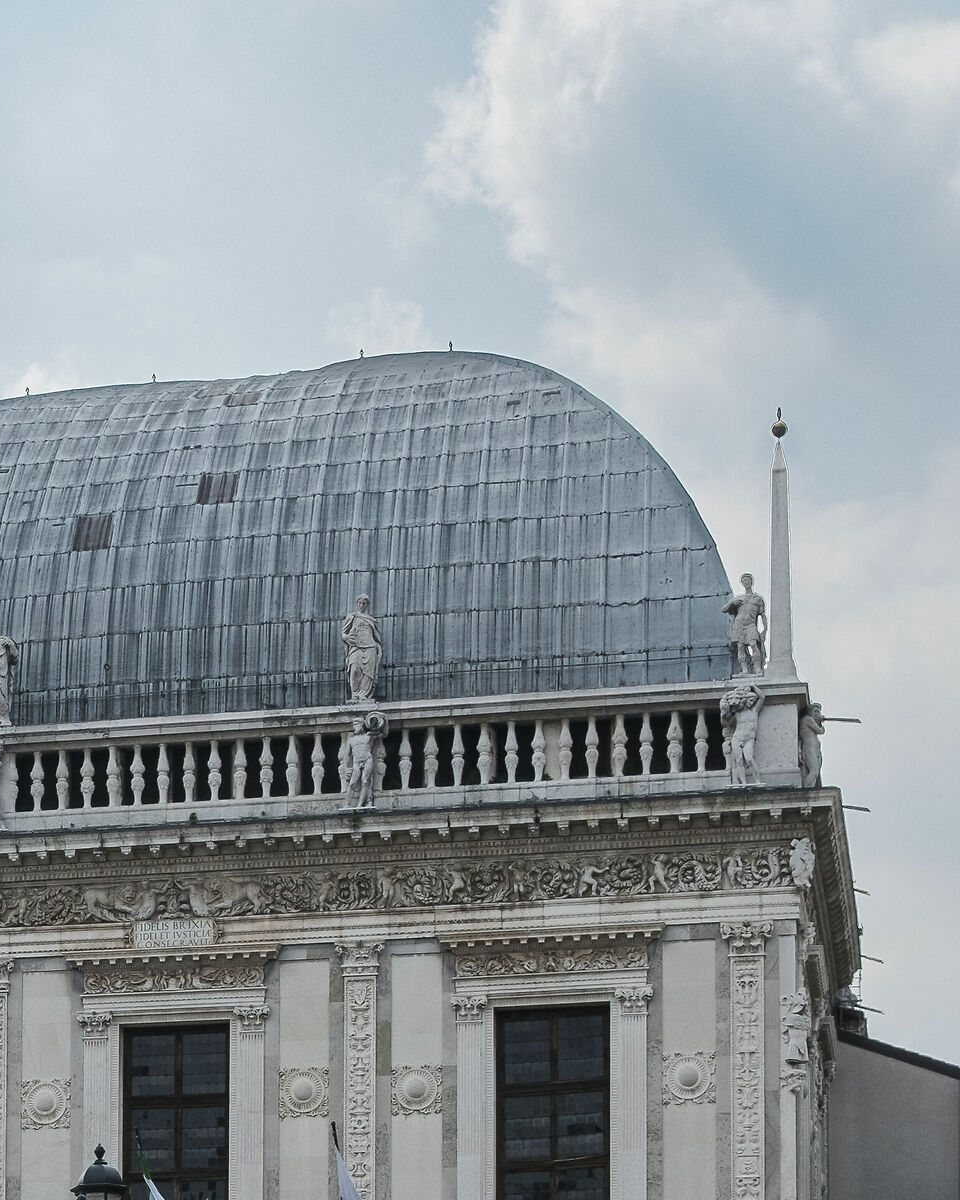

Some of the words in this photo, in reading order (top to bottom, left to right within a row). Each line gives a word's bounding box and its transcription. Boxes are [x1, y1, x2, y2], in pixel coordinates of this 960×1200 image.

[135, 922, 169, 932] FIDELIS
[173, 920, 211, 930] BRIXIA
[135, 932, 157, 941] FIDEI
